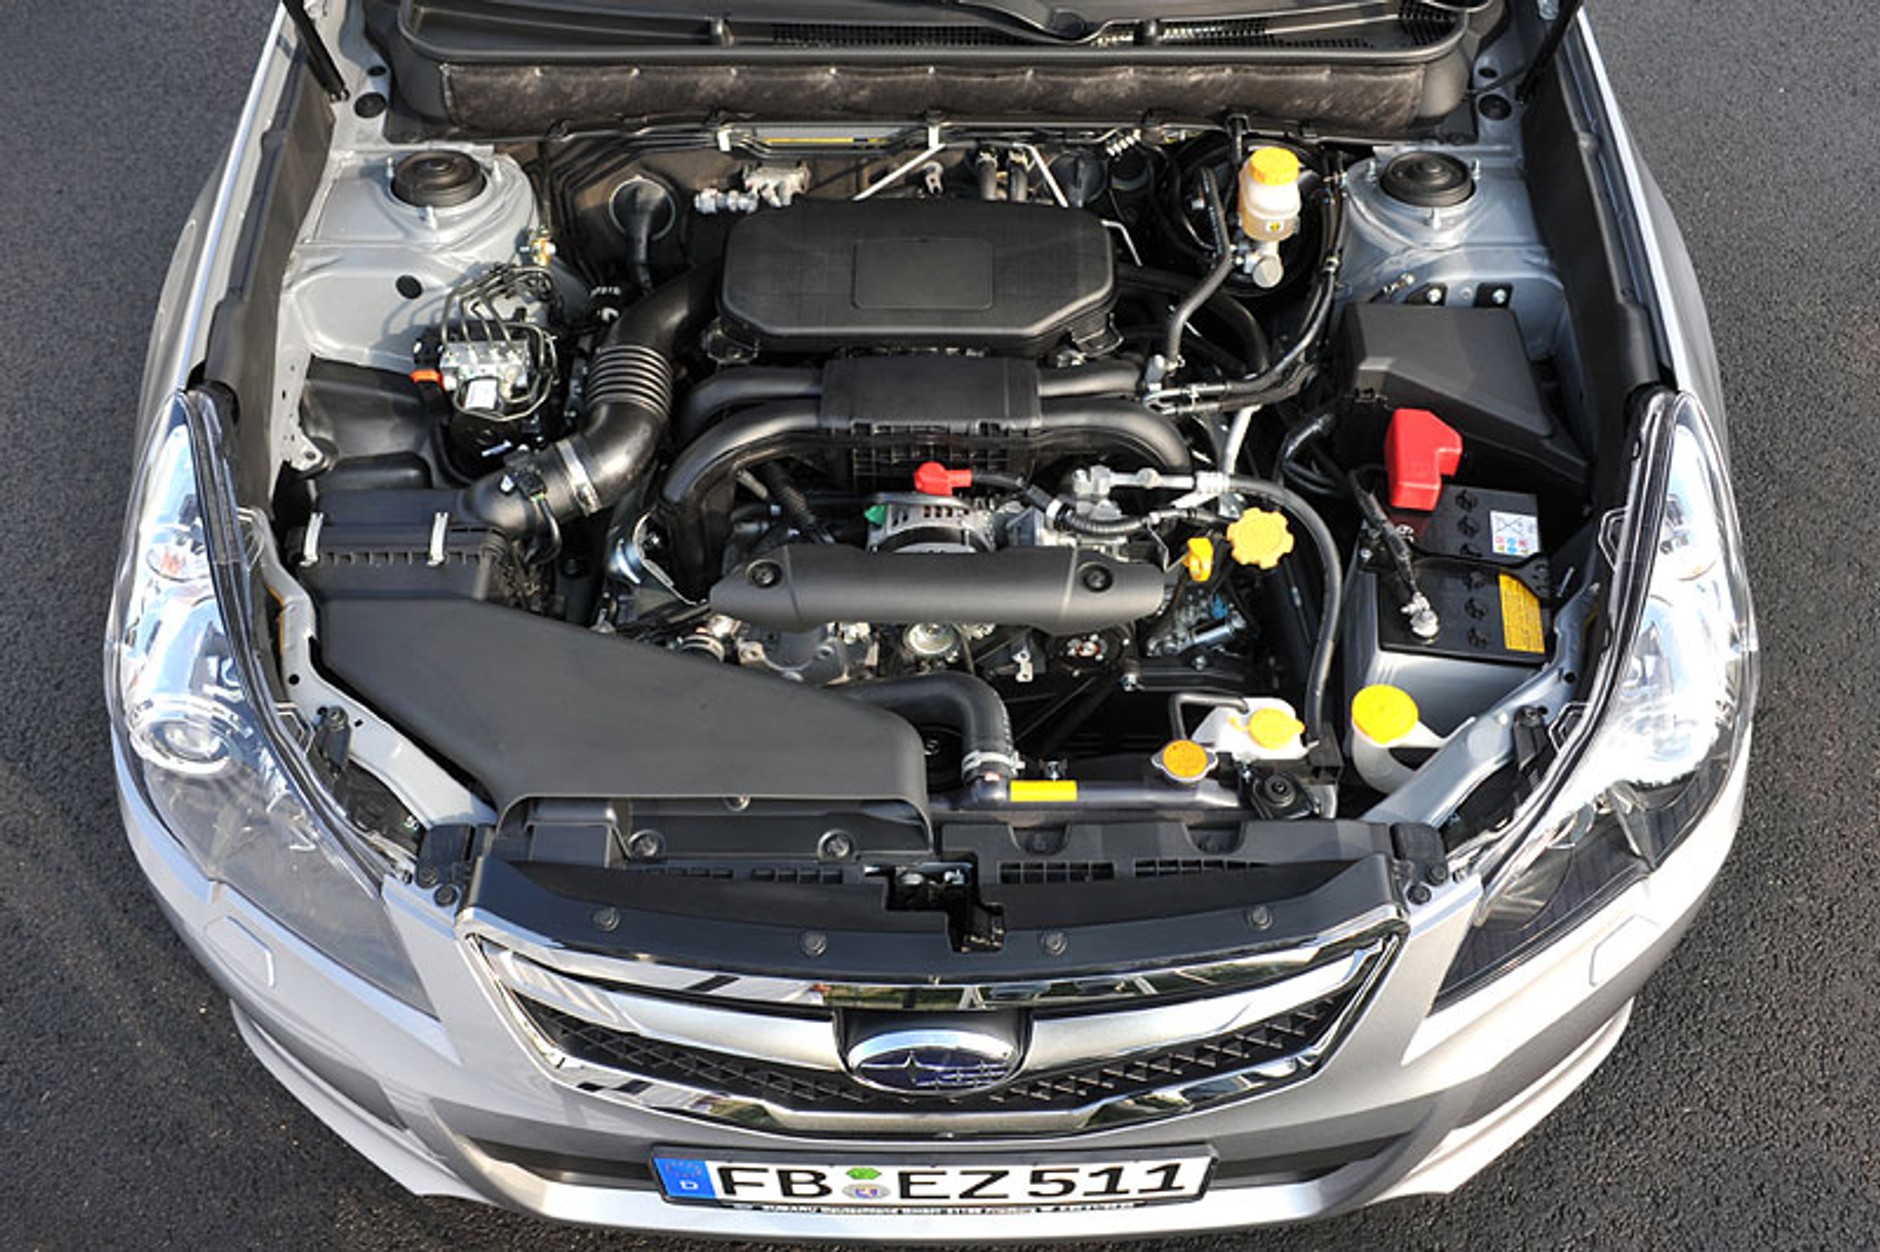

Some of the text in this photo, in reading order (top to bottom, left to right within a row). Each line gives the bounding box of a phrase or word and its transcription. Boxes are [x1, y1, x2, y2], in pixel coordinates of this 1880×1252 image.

[679, 1180, 699, 1190] D
[717, 1163, 1186, 1199] FB EZ 511
